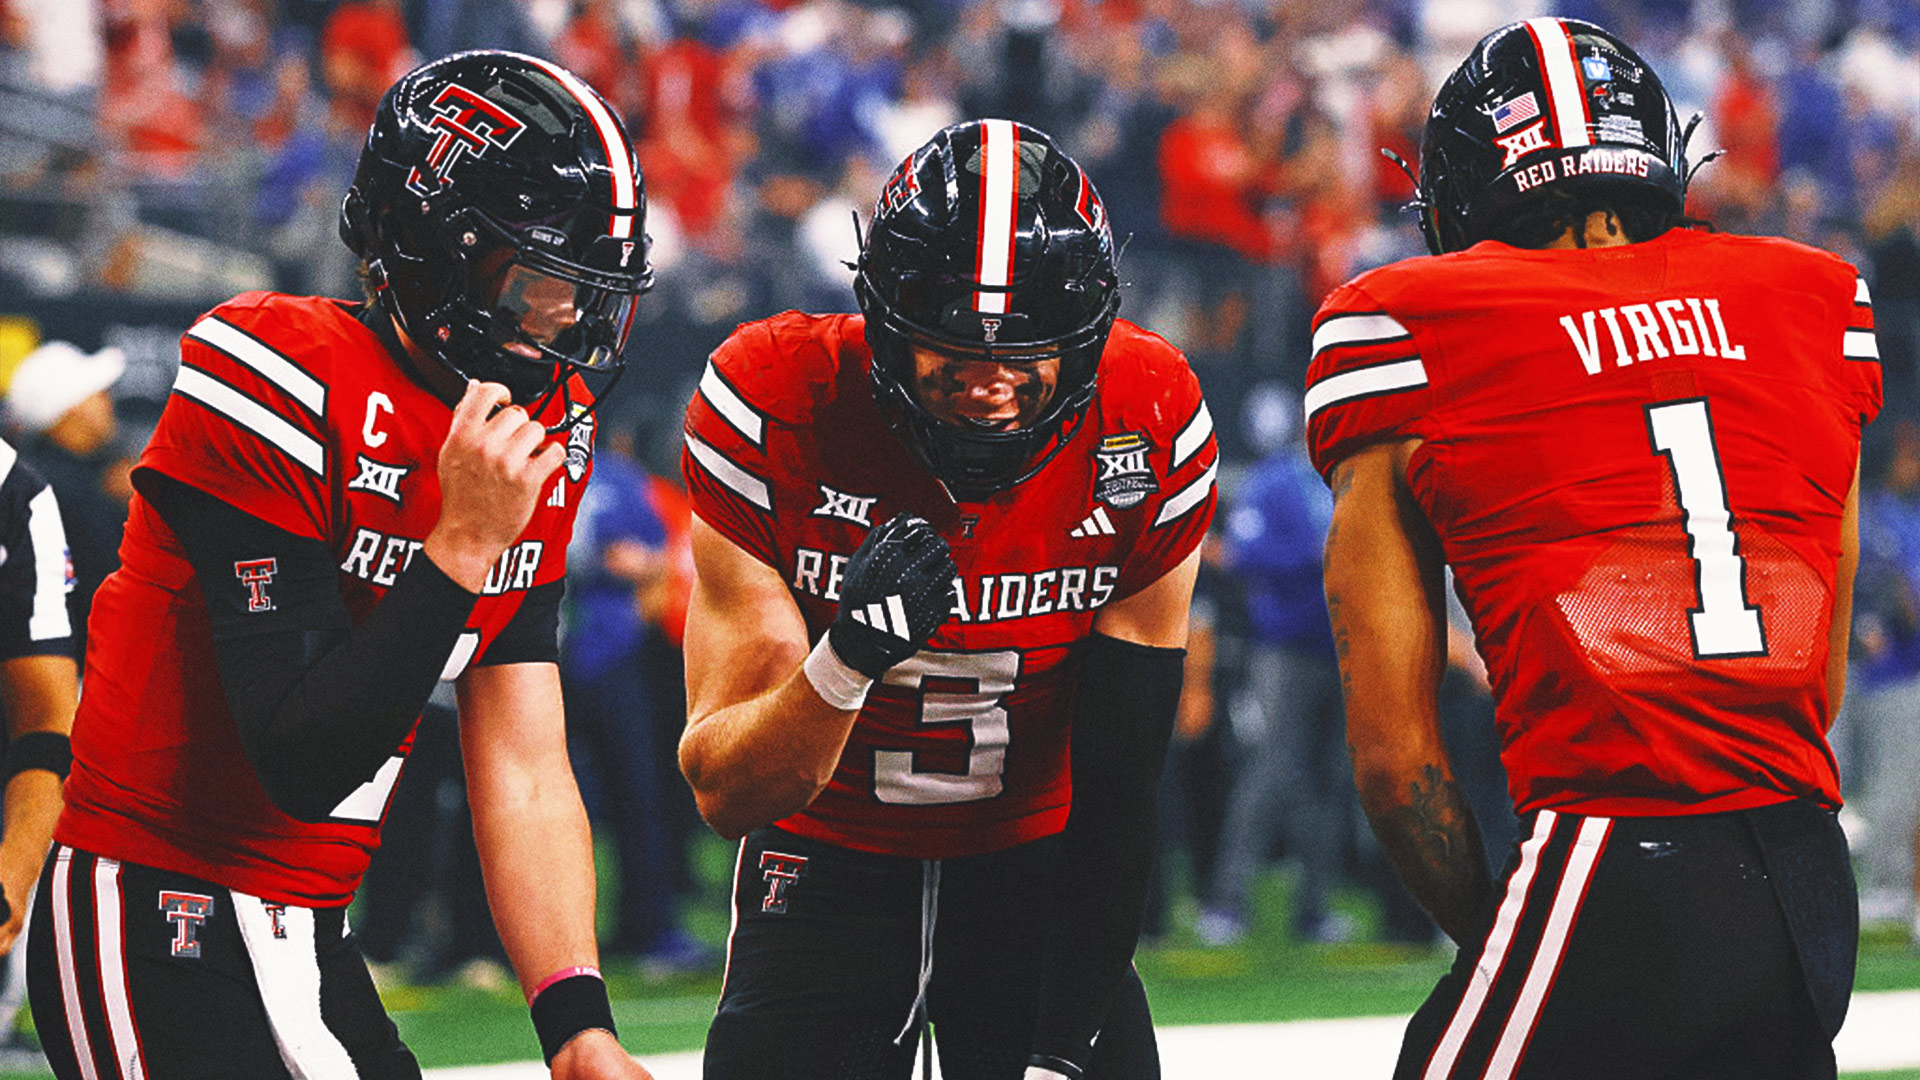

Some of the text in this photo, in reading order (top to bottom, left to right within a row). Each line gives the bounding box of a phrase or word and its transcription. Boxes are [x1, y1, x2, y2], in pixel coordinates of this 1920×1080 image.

[1494, 117, 1553, 170] XII
[1514, 151, 1650, 192] RED RAIDERS
[1560, 298, 1746, 375] VIRGIL
[362, 391, 394, 448] C
[348, 456, 407, 501] XII
[1096, 446, 1151, 480] XII
[814, 485, 878, 527] XII
[1645, 398, 1767, 658] 1
[875, 650, 1019, 804] 3
